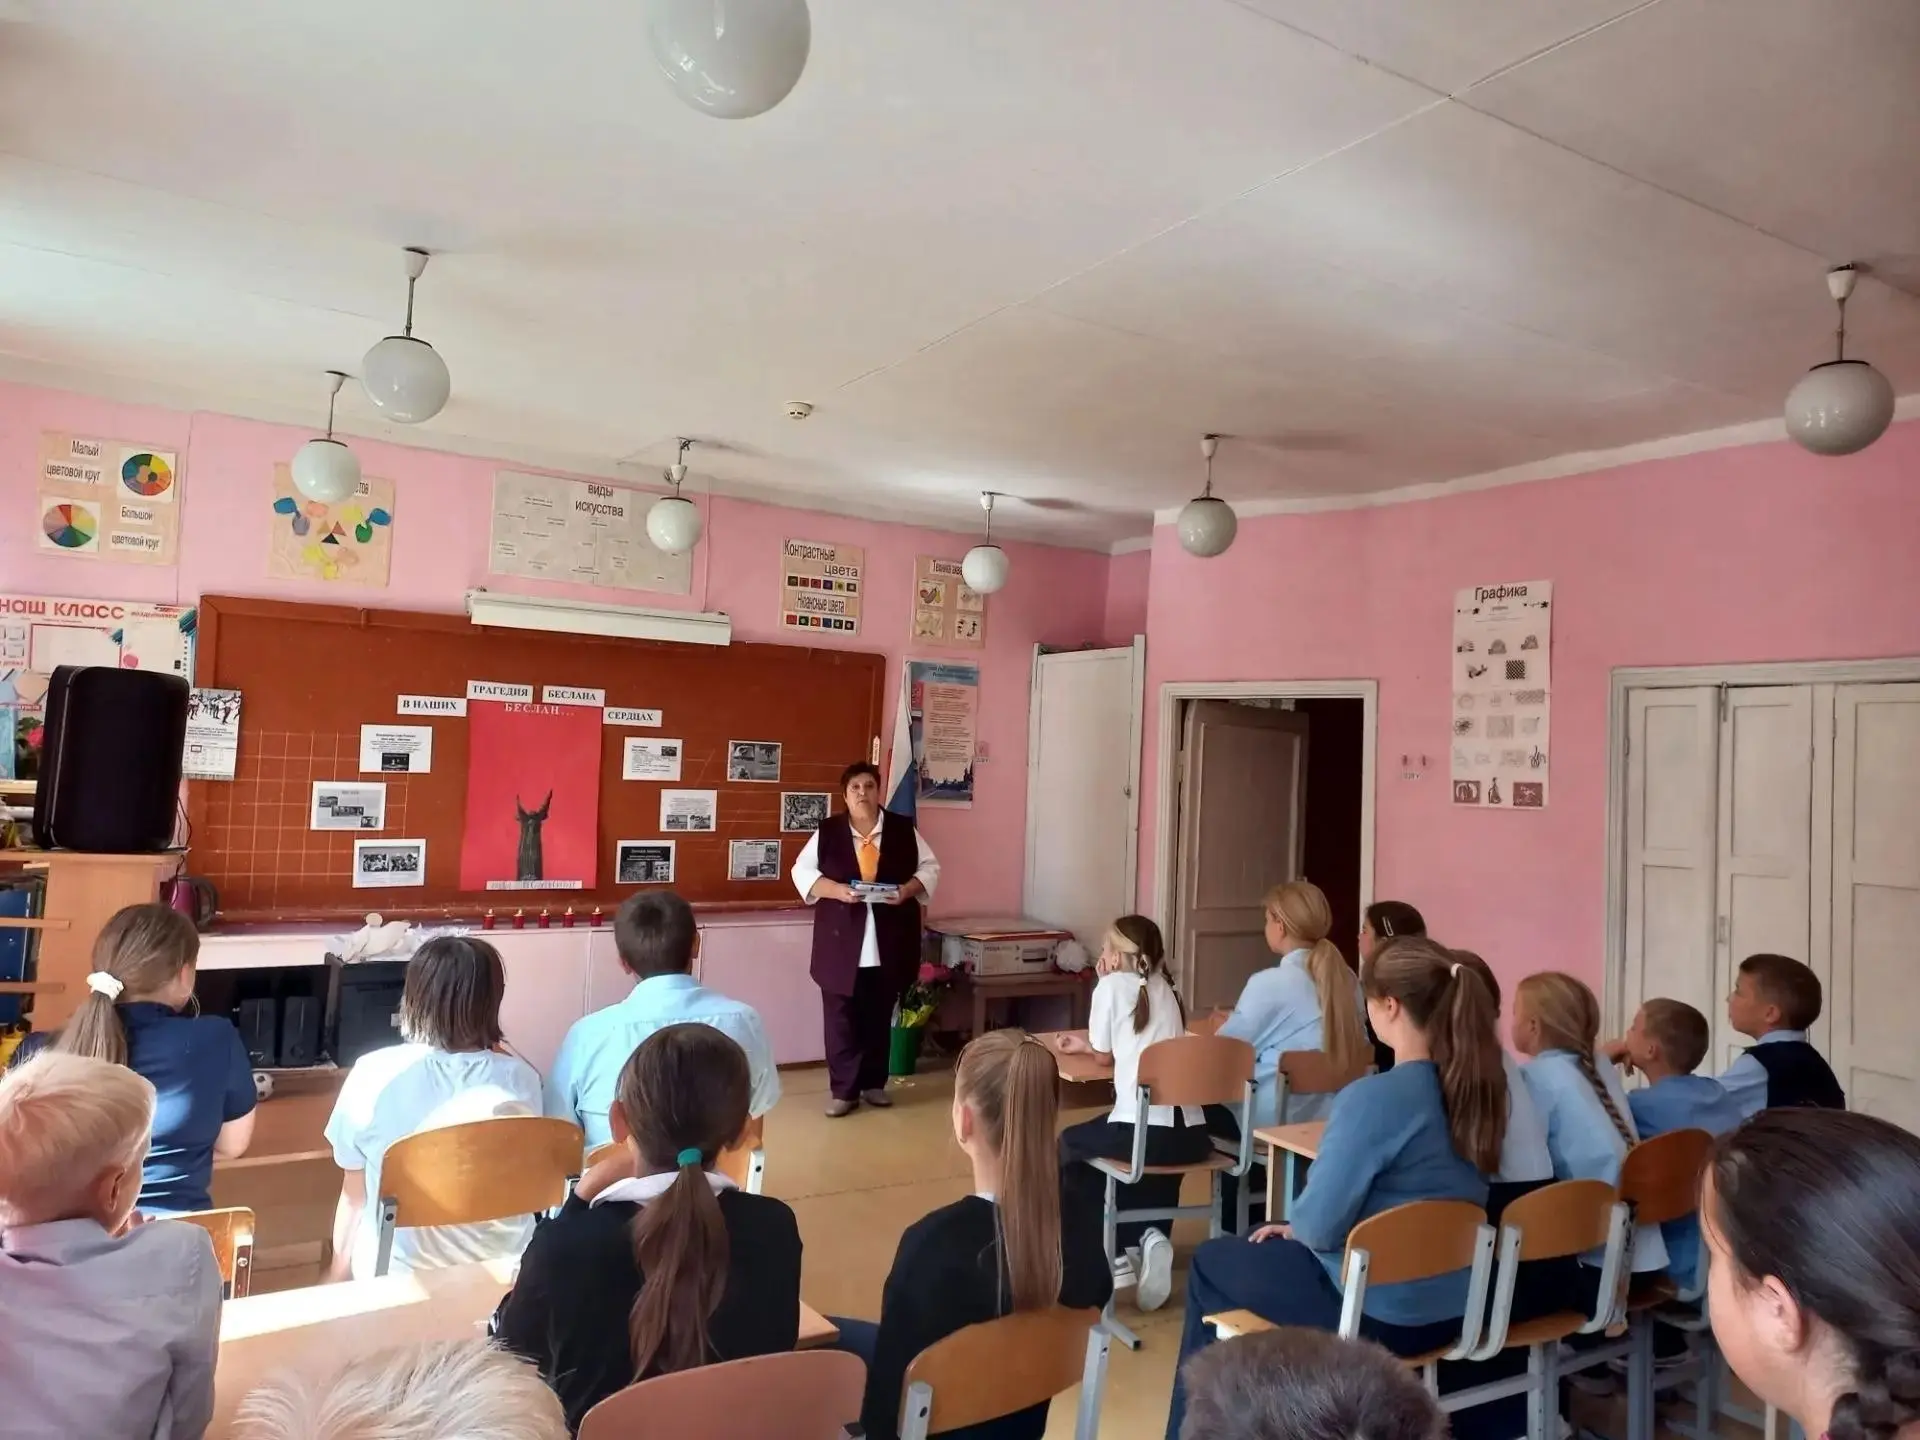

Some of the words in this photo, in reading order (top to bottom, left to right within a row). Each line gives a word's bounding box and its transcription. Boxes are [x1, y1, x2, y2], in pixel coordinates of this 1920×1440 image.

[71, 440, 99, 456] Малый
[46, 464, 83, 479] цветовой
[85, 469, 100, 484] круг
[588, 483, 614, 498] виды
[575, 500, 623, 517] искусства
[111, 534, 144, 546] цветовой
[145, 538, 160, 550] круг
[784, 540, 835, 562] Контрастные
[824, 564, 858, 578] цвета
[1475, 585, 1528, 603] Графика
[54, 602, 125, 620] класс
[828, 599, 845, 613] цвета
[472, 685, 529, 698] ТРАГЕДИЯ
[547, 690, 597, 701] БЕСЛАНА
[402, 700, 411, 710] В
[414, 700, 457, 710] НАШИХ
[607, 711, 654, 722] СЕРДЦАХ
